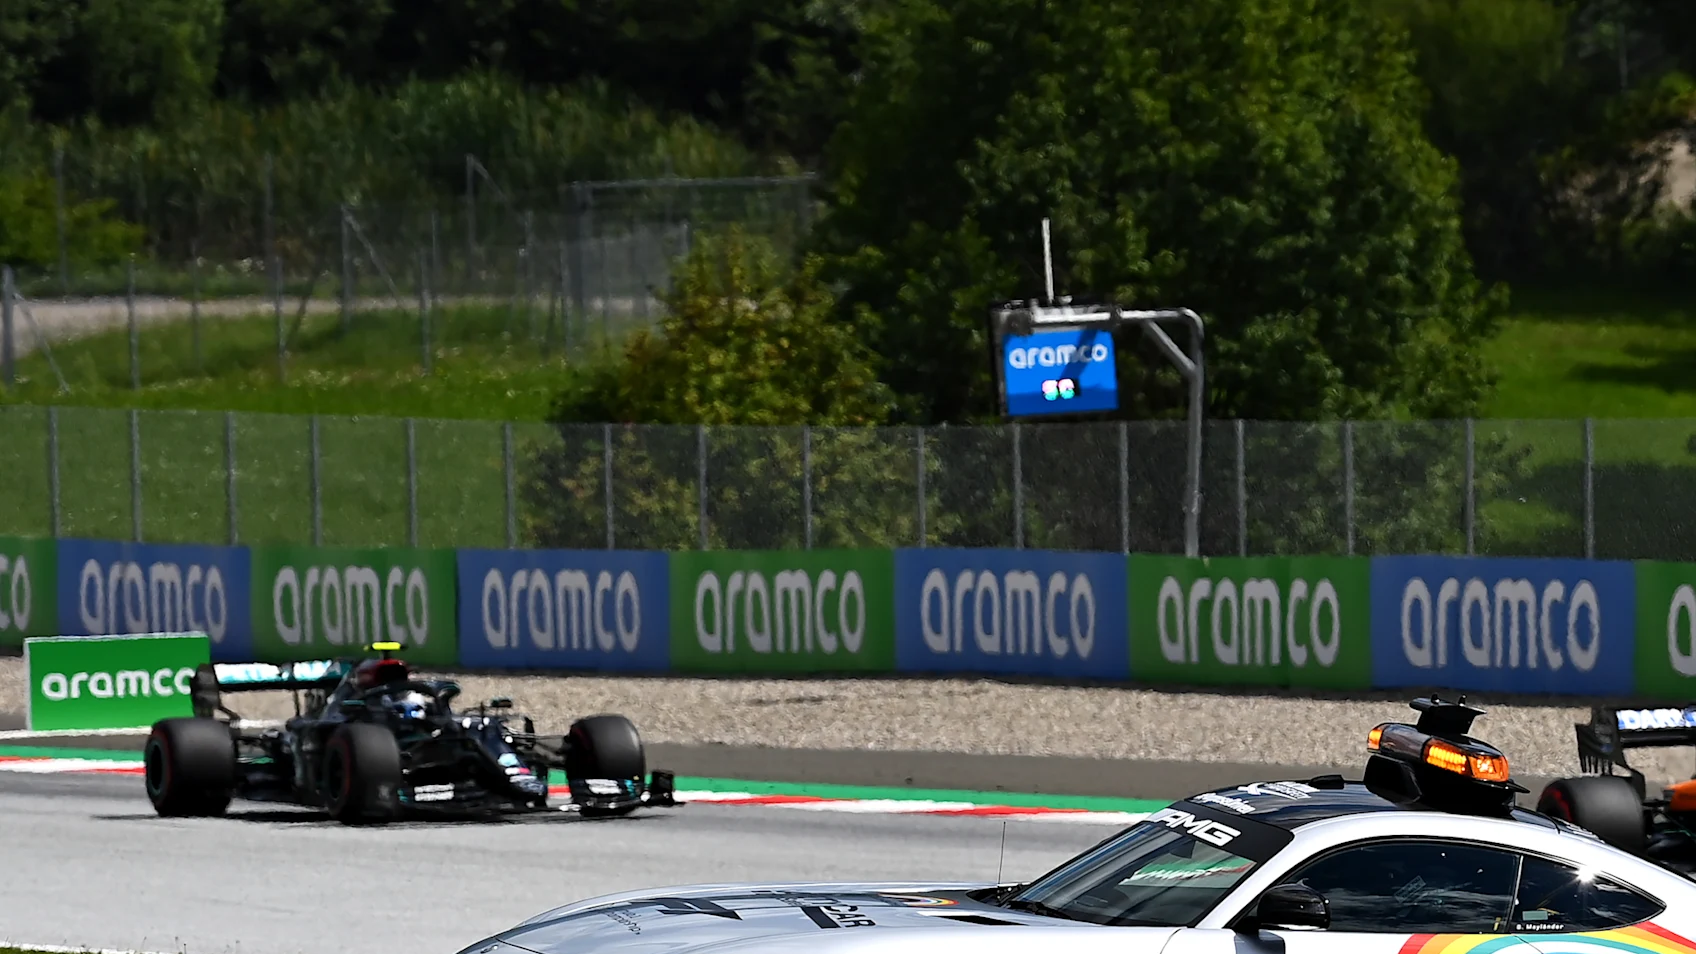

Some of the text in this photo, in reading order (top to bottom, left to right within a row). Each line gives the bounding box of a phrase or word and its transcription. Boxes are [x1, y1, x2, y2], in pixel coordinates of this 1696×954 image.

[1009, 344, 1108, 369] aramco
[80, 559, 226, 644] aramco
[273, 565, 428, 646] aramco
[482, 567, 640, 651] aramco
[695, 568, 866, 654] aramco
[921, 568, 1096, 658] aramco
[1157, 575, 1341, 667] aramco
[1402, 577, 1599, 671] aramco
[1154, 808, 1241, 847] AMG
